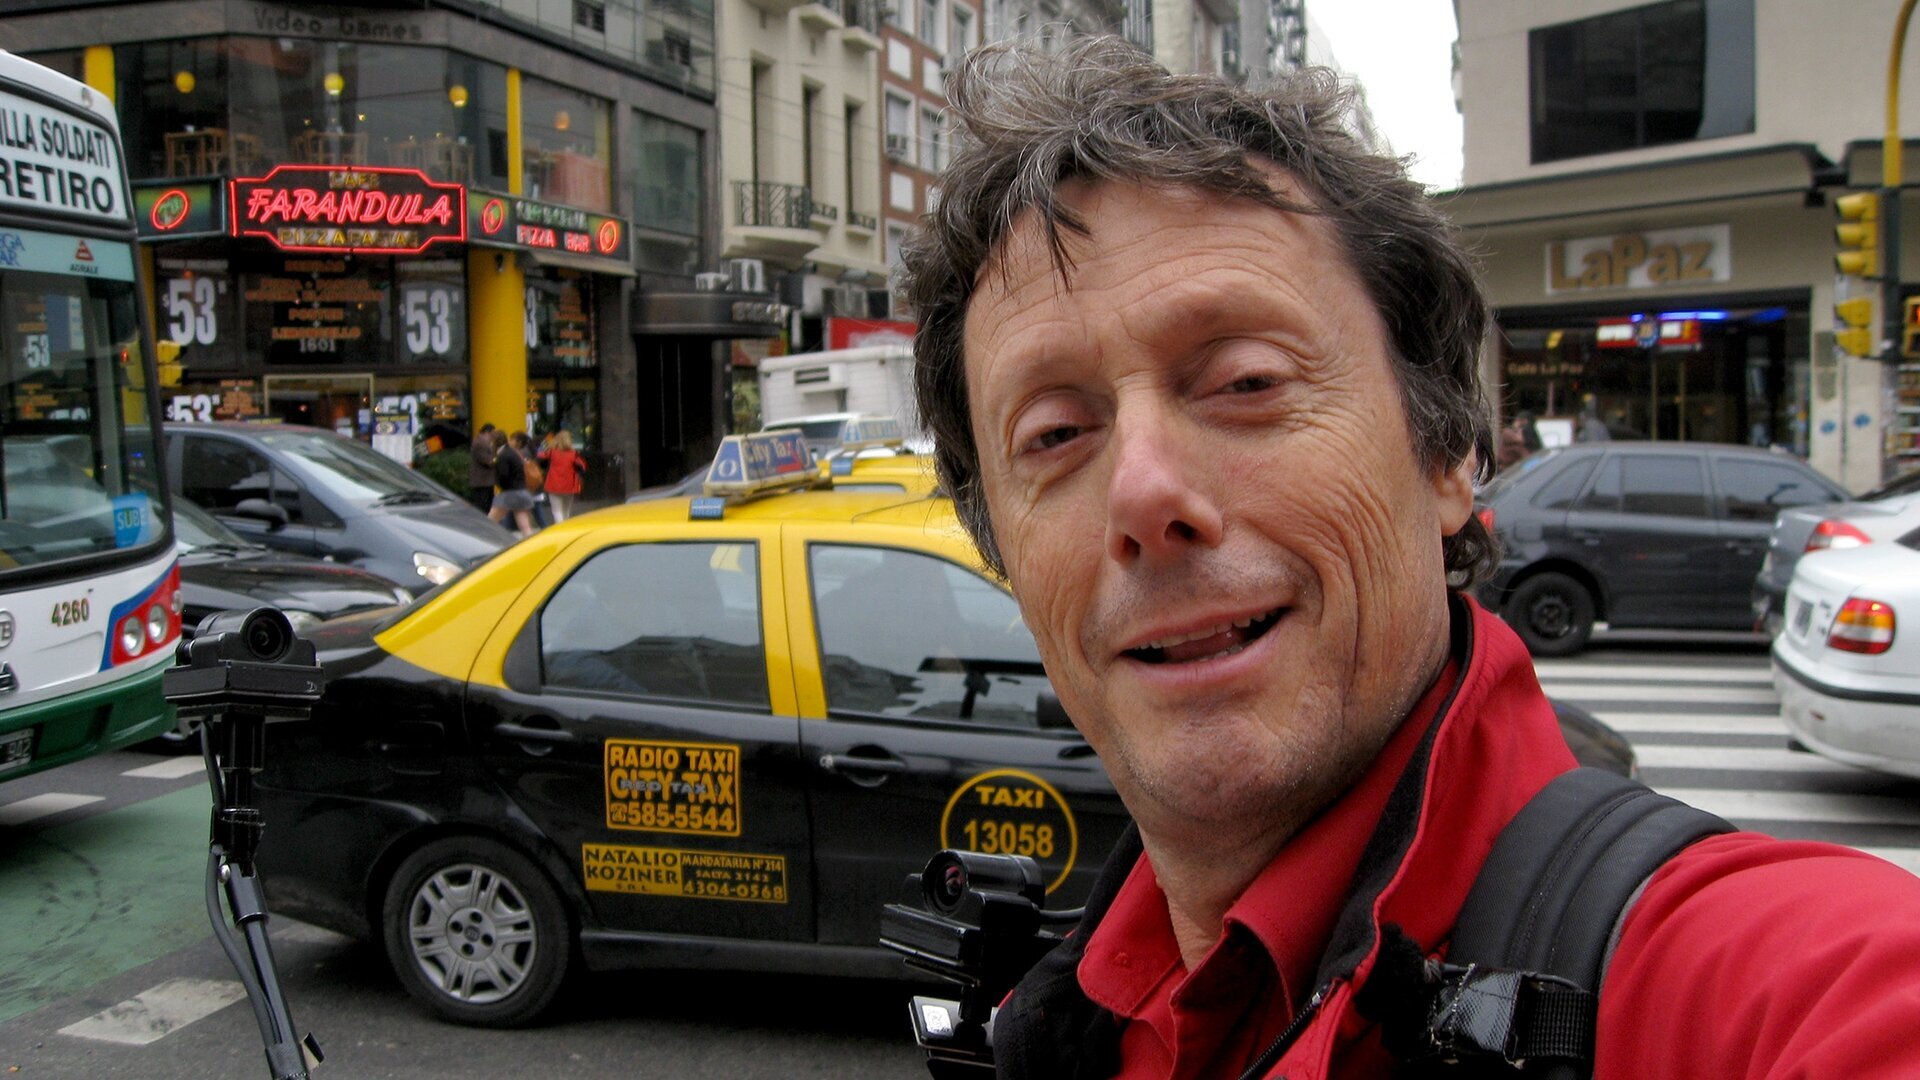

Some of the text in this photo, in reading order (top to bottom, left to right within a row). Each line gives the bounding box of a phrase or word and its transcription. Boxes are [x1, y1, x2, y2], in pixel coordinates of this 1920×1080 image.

[40, 117, 110, 168] SOLDATI
[248, 188, 453, 226] FARANDULA
[278, 227, 345, 245] PIZZA
[517, 225, 556, 248] PIZZA
[299, 338, 336, 353] 1601
[52, 599, 90, 626] 4260
[610, 746, 733, 773] RADIO TAXI
[610, 768, 733, 805] CITY TAX
[975, 786, 1044, 808] TAXI
[964, 820, 1053, 858] 13058
[584, 848, 678, 867] NATALIO
[682, 855, 750, 868] MANDATARIA
[586, 865, 678, 884] KOZINER
[696, 870, 731, 879] SALTA
[684, 881, 784, 900] 4304-0568
